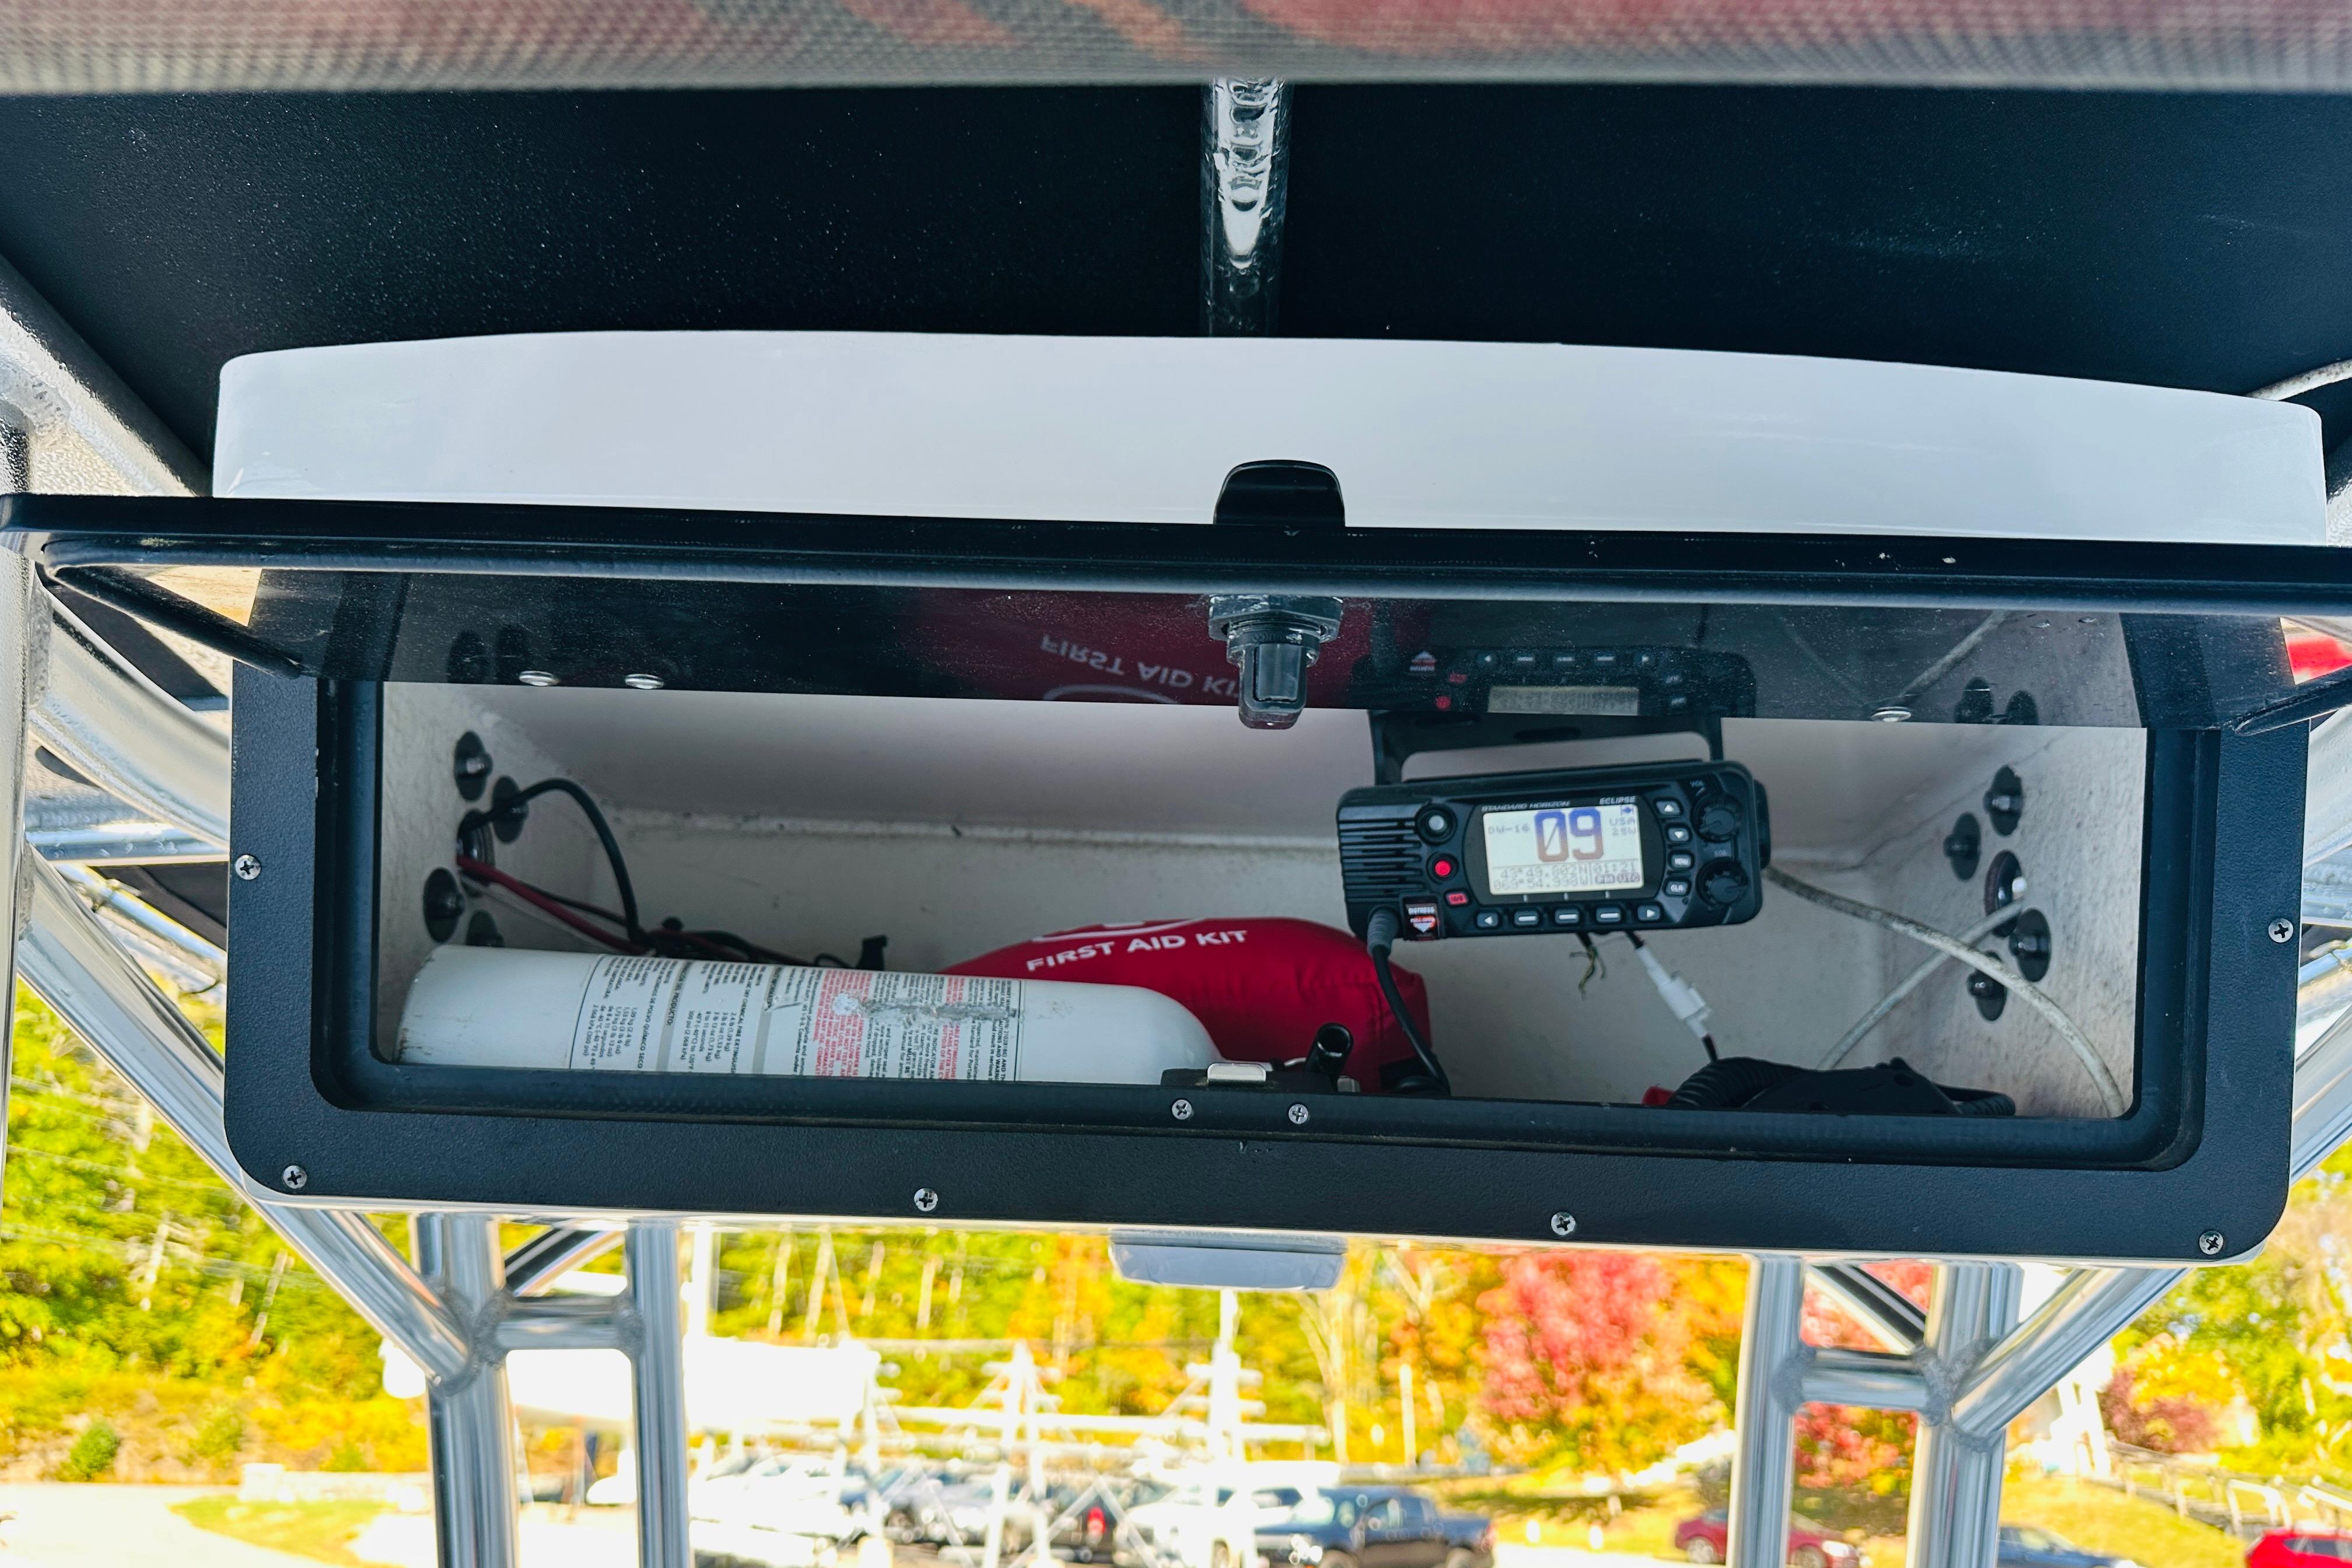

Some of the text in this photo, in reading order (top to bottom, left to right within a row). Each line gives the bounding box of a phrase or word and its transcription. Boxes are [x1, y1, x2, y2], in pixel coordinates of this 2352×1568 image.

[1482, 800, 1570, 812] STANDARD HORIZON
[1600, 796, 1637, 805] ECLIPSE
[1609, 818, 1636, 826] USA
[1534, 807, 1604, 863] 09
[1674, 858, 1690, 866] MENU
[1670, 883, 1684, 891] CLR
[1408, 907, 1435, 915] DISTRESS
[1026, 930, 1247, 972] FIRST AID KIT
[646, 1005, 654, 1023] POLVO
[666, 992, 680, 1026] PRODUCTO:
[738, 999, 748, 1024] CHEMICAL
[803, 1016, 812, 1043] phosphate
[813, 1007, 822, 1041] DISCARDING.
[845, 1028, 850, 1037] DO
[599, 1030, 608, 1058] segundos
[640, 1024, 650, 1051] QUÍMICO
[796, 1028, 804, 1054] Contents
